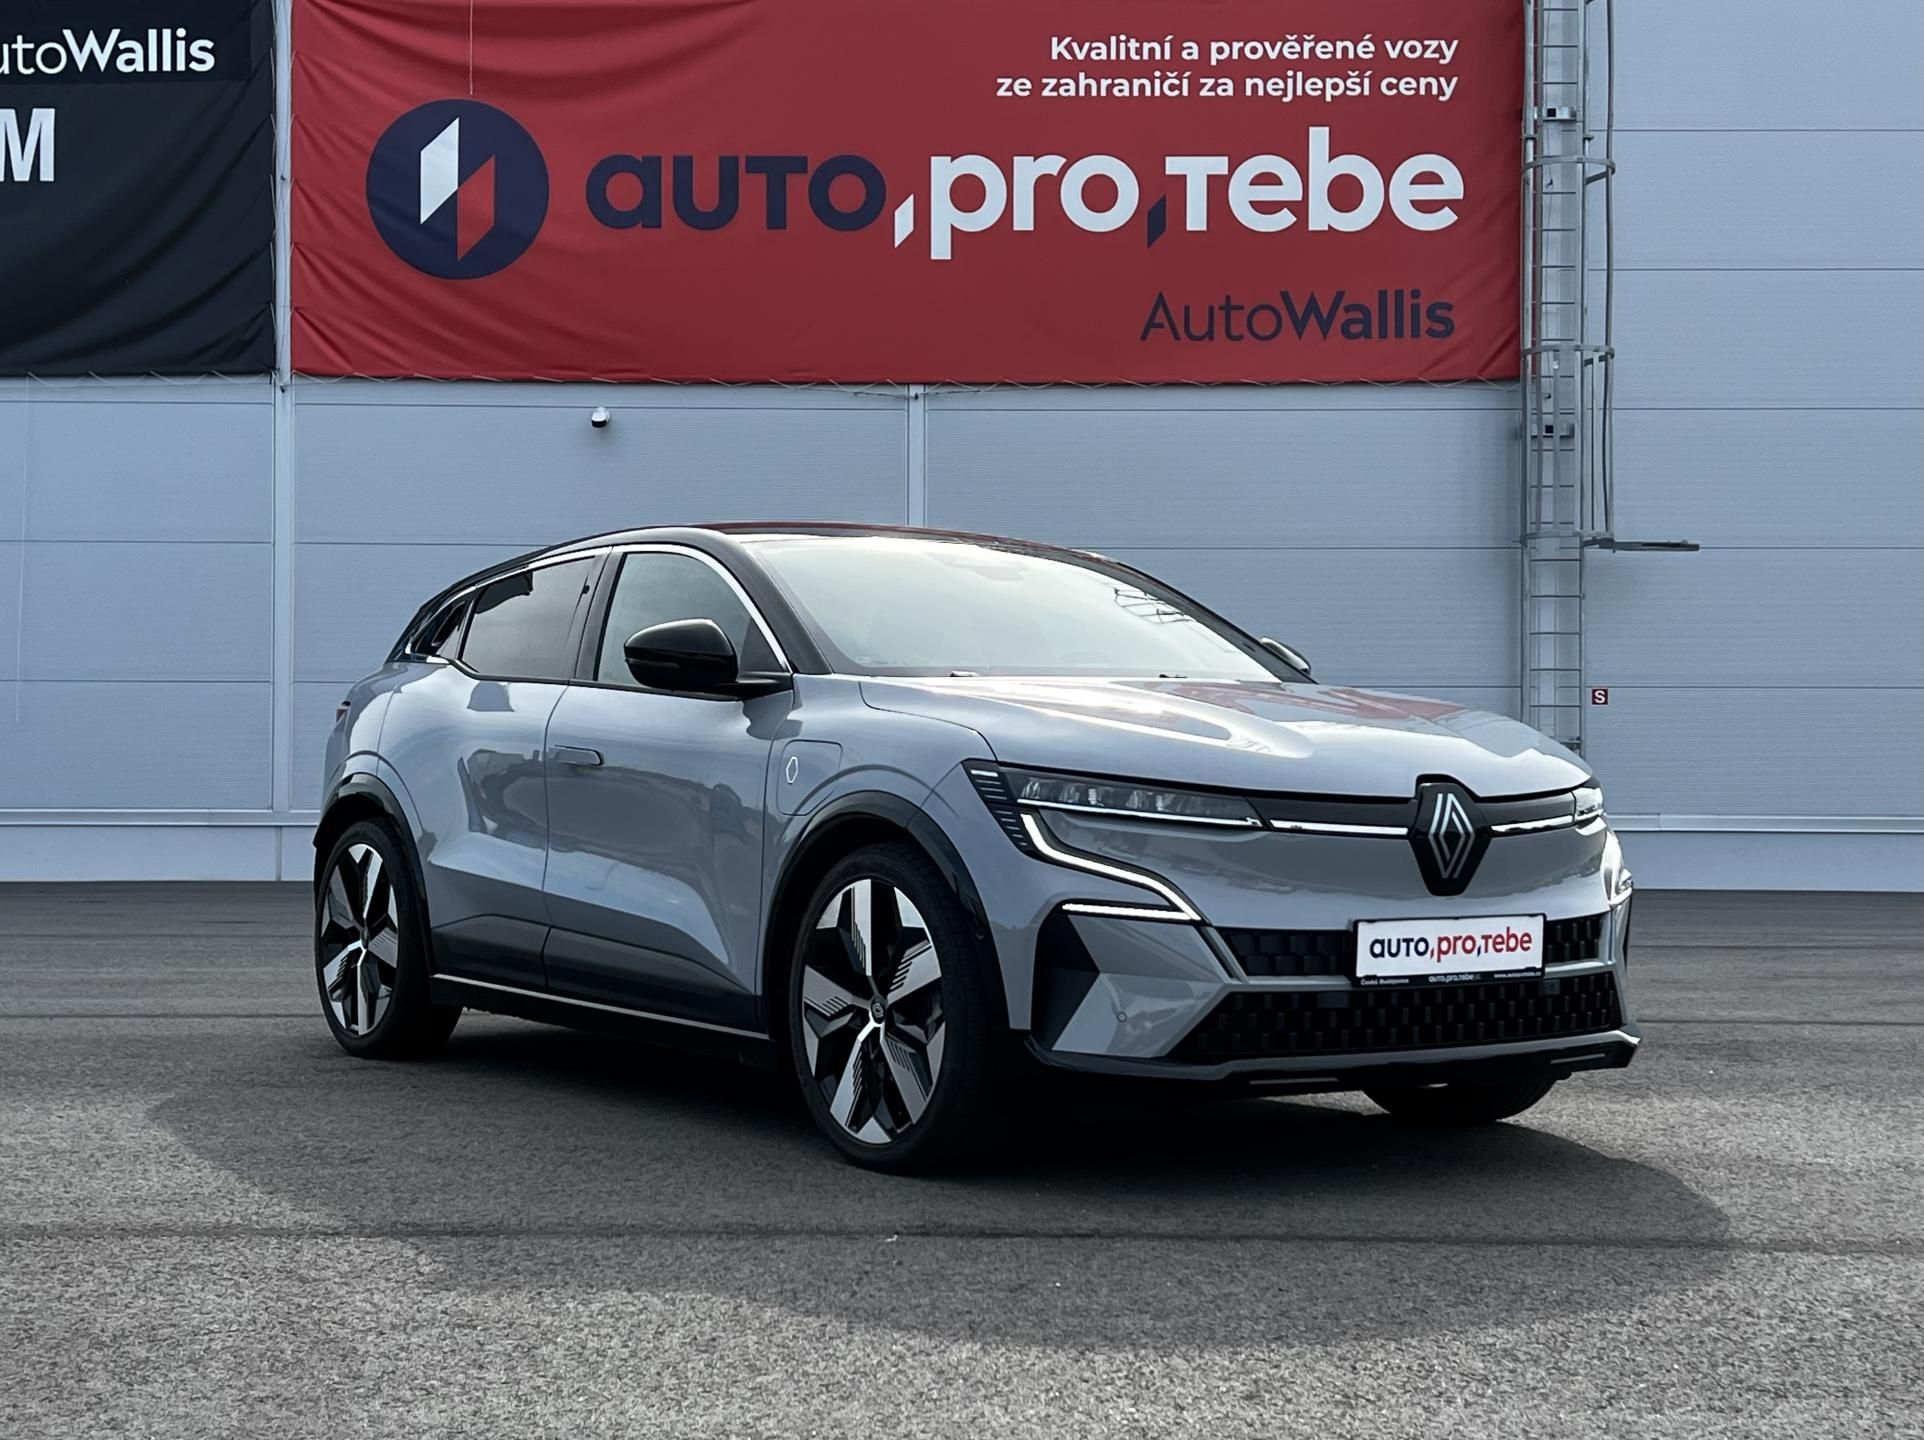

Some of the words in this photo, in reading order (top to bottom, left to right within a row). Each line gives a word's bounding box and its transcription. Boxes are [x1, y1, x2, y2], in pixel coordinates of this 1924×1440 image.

[1051, 34, 1174, 61] Kvalitní
[1182, 41, 1199, 61] a
[1210, 33, 1376, 66] prověřené
[1384, 39, 1459, 66] vozy
[996, 77, 1032, 97] ze
[1041, 70, 1192, 97] zahraničí
[1199, 77, 1234, 97] za
[1245, 70, 1373, 103] nejlepší
[1380, 76, 1459, 102] ceny
[1140, 288, 1456, 342] AutoWallis
[1594, 690, 1606, 704] S
